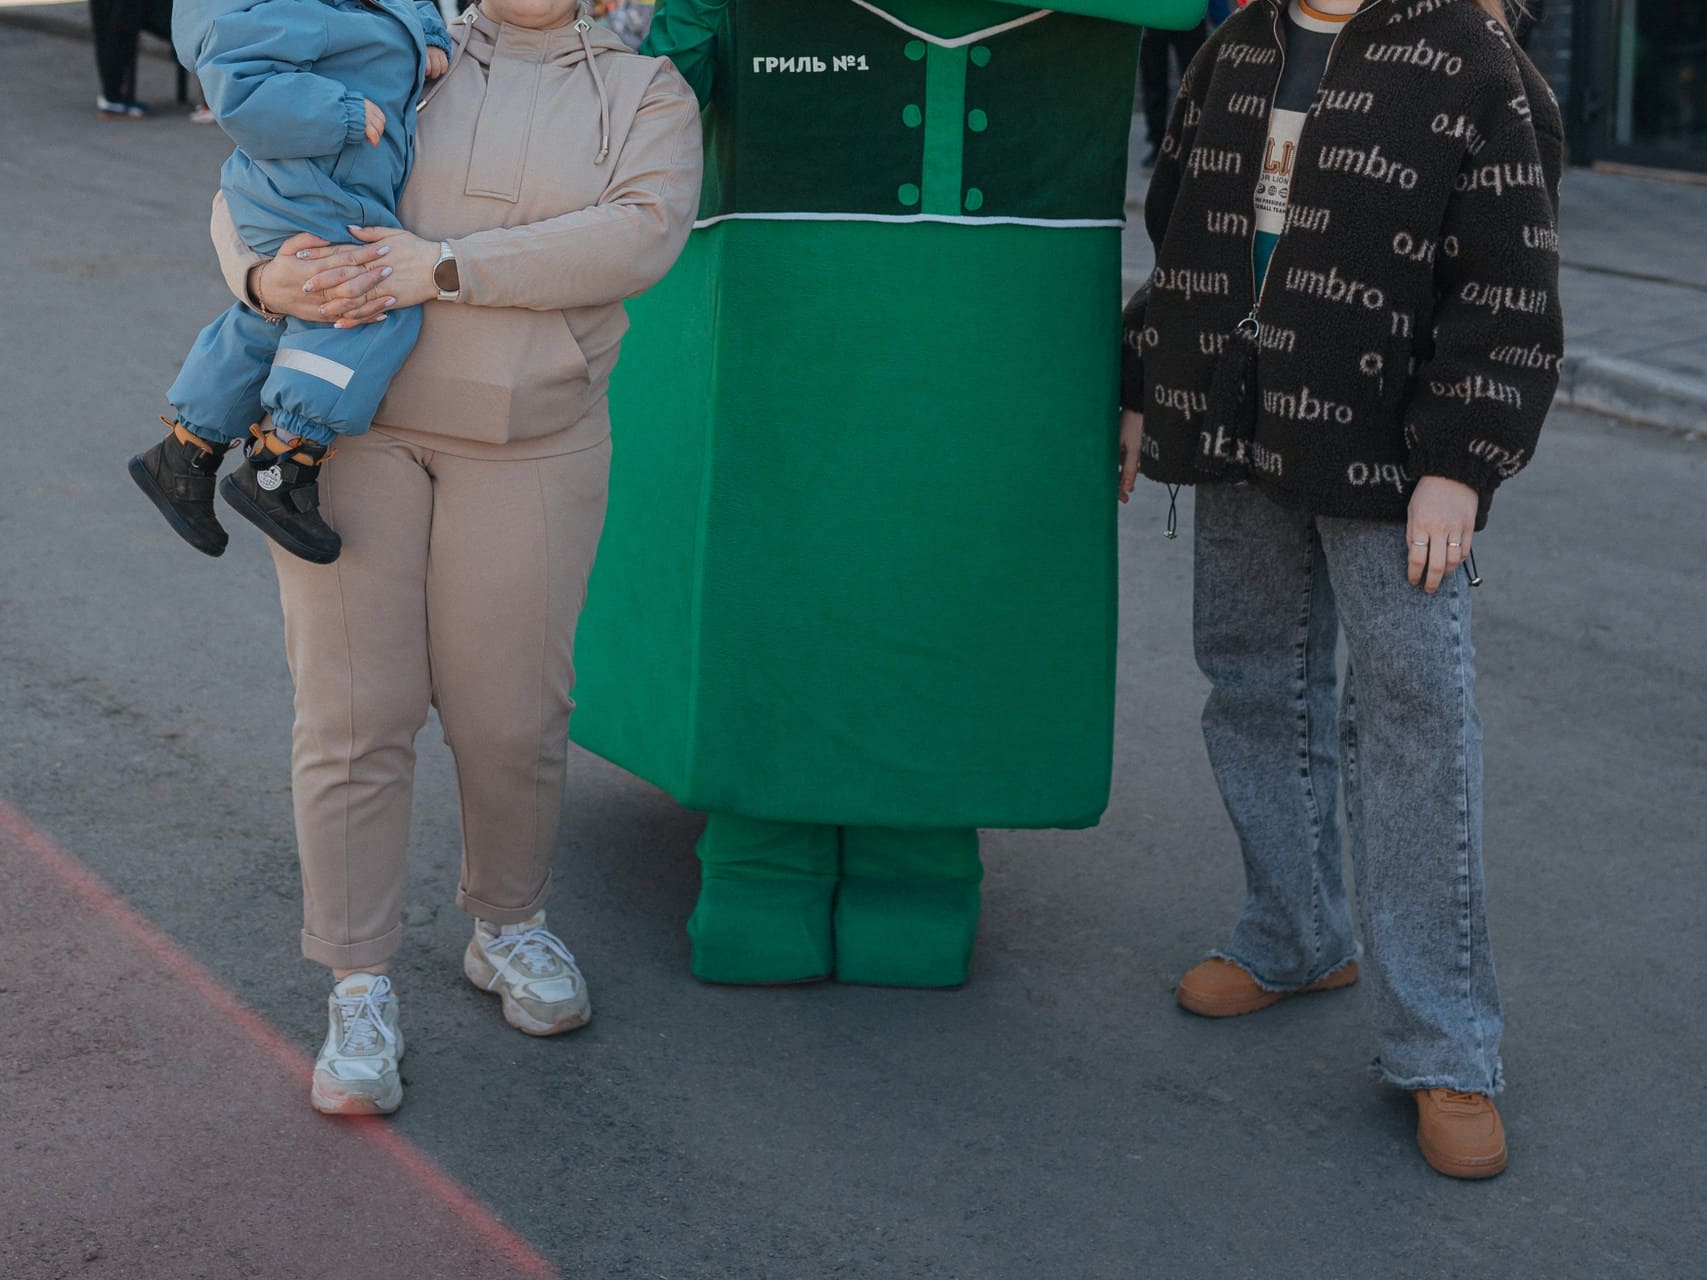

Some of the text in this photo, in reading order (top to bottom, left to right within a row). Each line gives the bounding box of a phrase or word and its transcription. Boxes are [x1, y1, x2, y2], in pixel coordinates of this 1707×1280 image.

[753, 54, 870, 73] ГРИЛЬ №1
[1364, 38, 1463, 76] umbro
[1317, 145, 1419, 190] umbro
[1154, 267, 1230, 301] umbro
[1284, 266, 1385, 311] umbro
[1263, 386, 1353, 423] umbro
